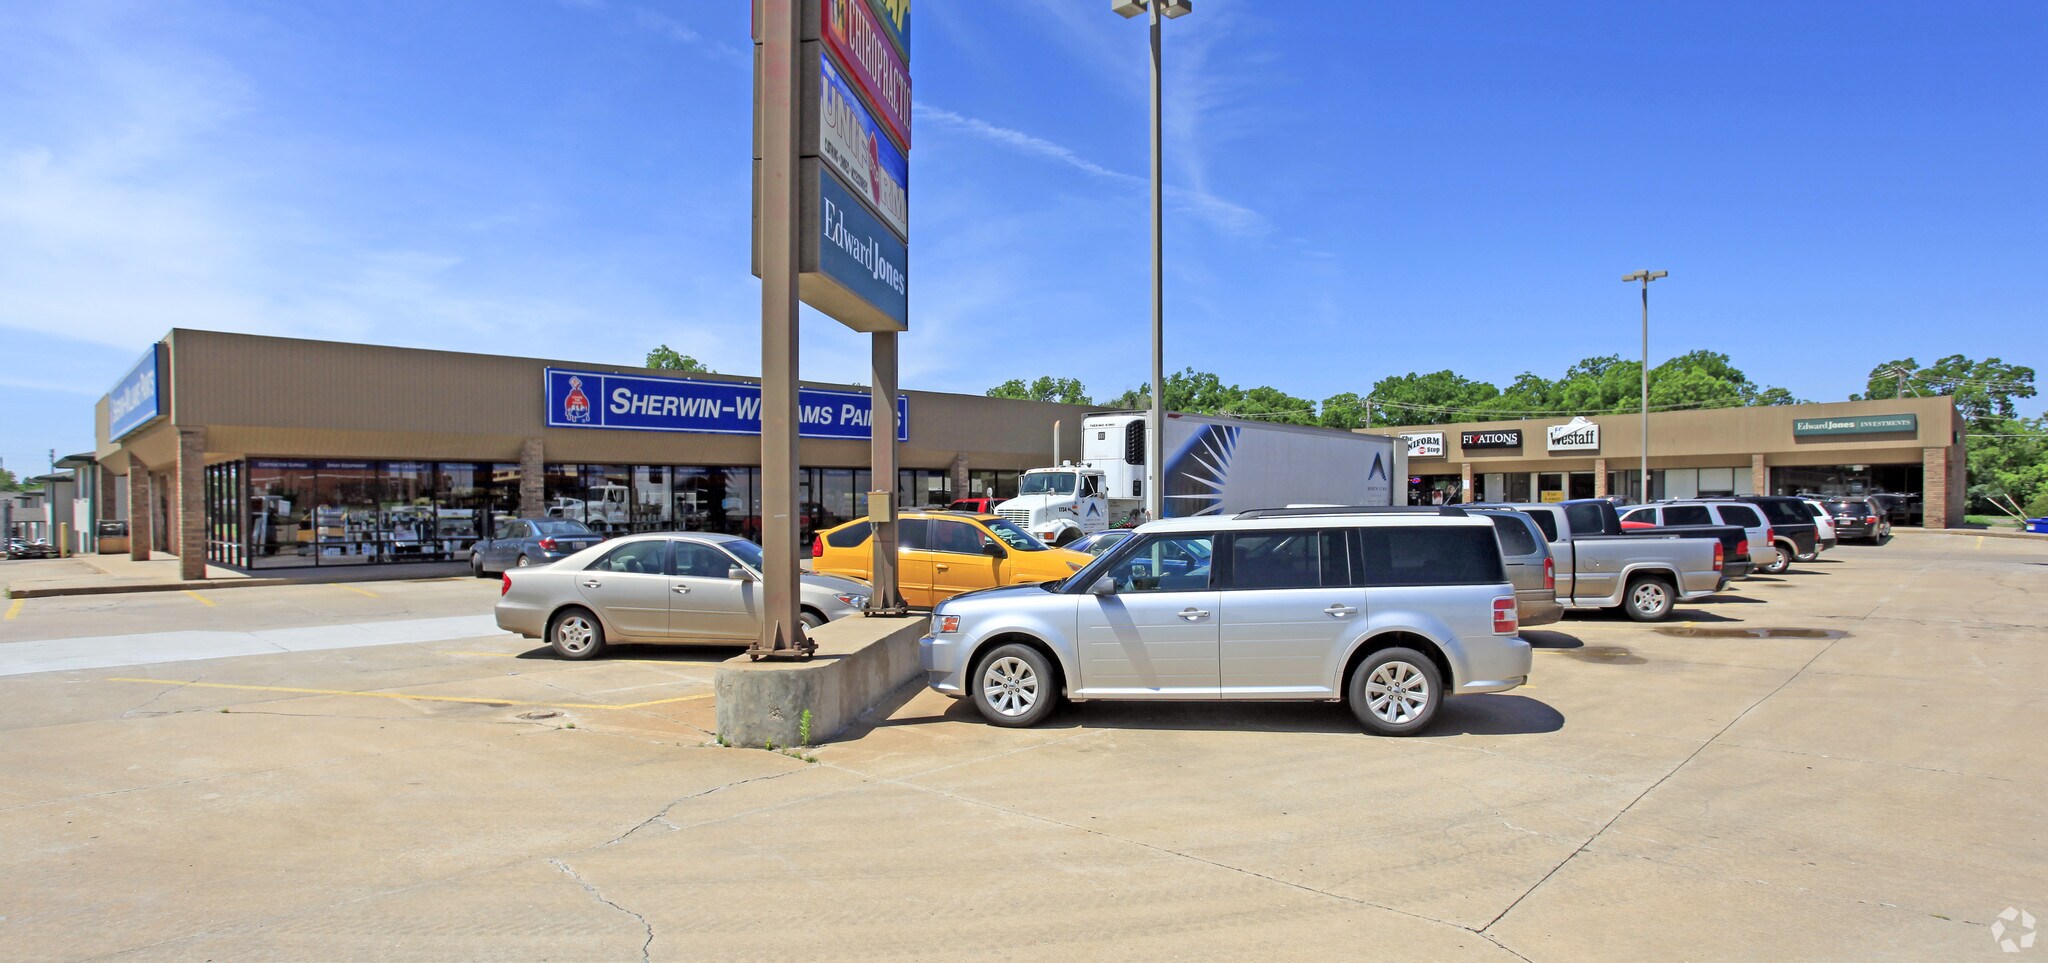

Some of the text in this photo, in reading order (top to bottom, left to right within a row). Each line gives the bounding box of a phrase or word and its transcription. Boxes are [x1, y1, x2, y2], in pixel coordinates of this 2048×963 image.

[849, 0, 911, 131] CHIROPRACTIC
[1860, 419, 1911, 428] INVESTMENTS
[1408, 436, 1440, 451] NIFORM
[1462, 432, 1518, 445] FIXATIONS
